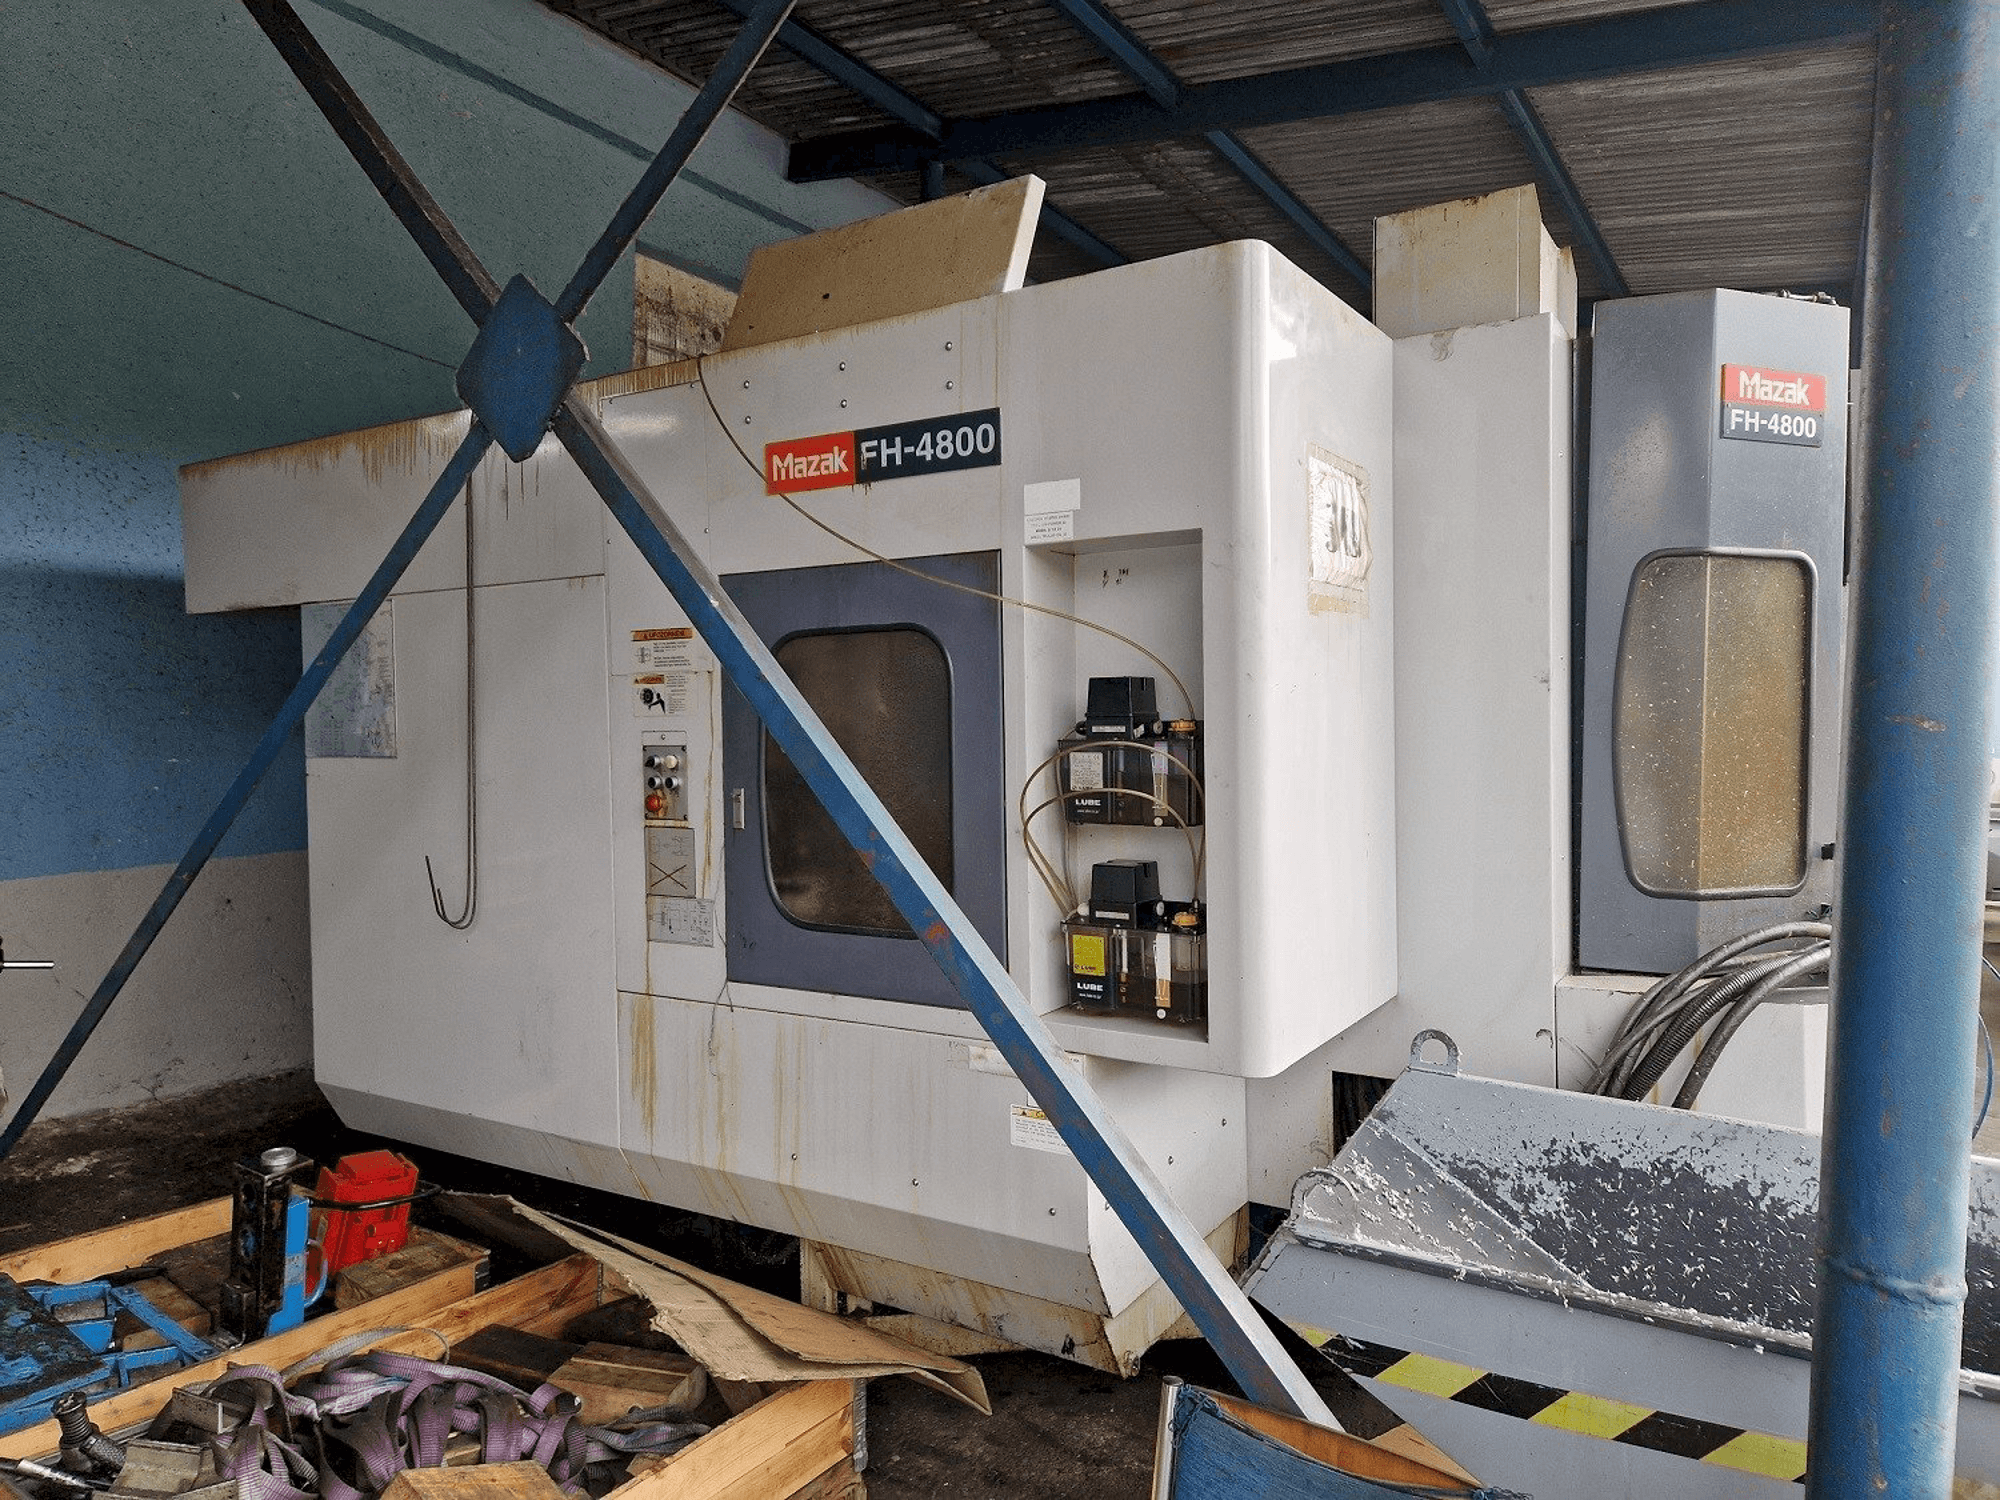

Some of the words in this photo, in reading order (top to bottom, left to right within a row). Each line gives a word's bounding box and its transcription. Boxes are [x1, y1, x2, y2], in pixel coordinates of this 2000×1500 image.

[1739, 370, 1810, 406] Mazak
[1730, 408, 1817, 438] FH-4800
[772, 446, 849, 482] Mazak
[860, 423, 996, 470] FH-4800
[1075, 798, 1102, 806] LUBE
[1076, 982, 1104, 992] LUBE
